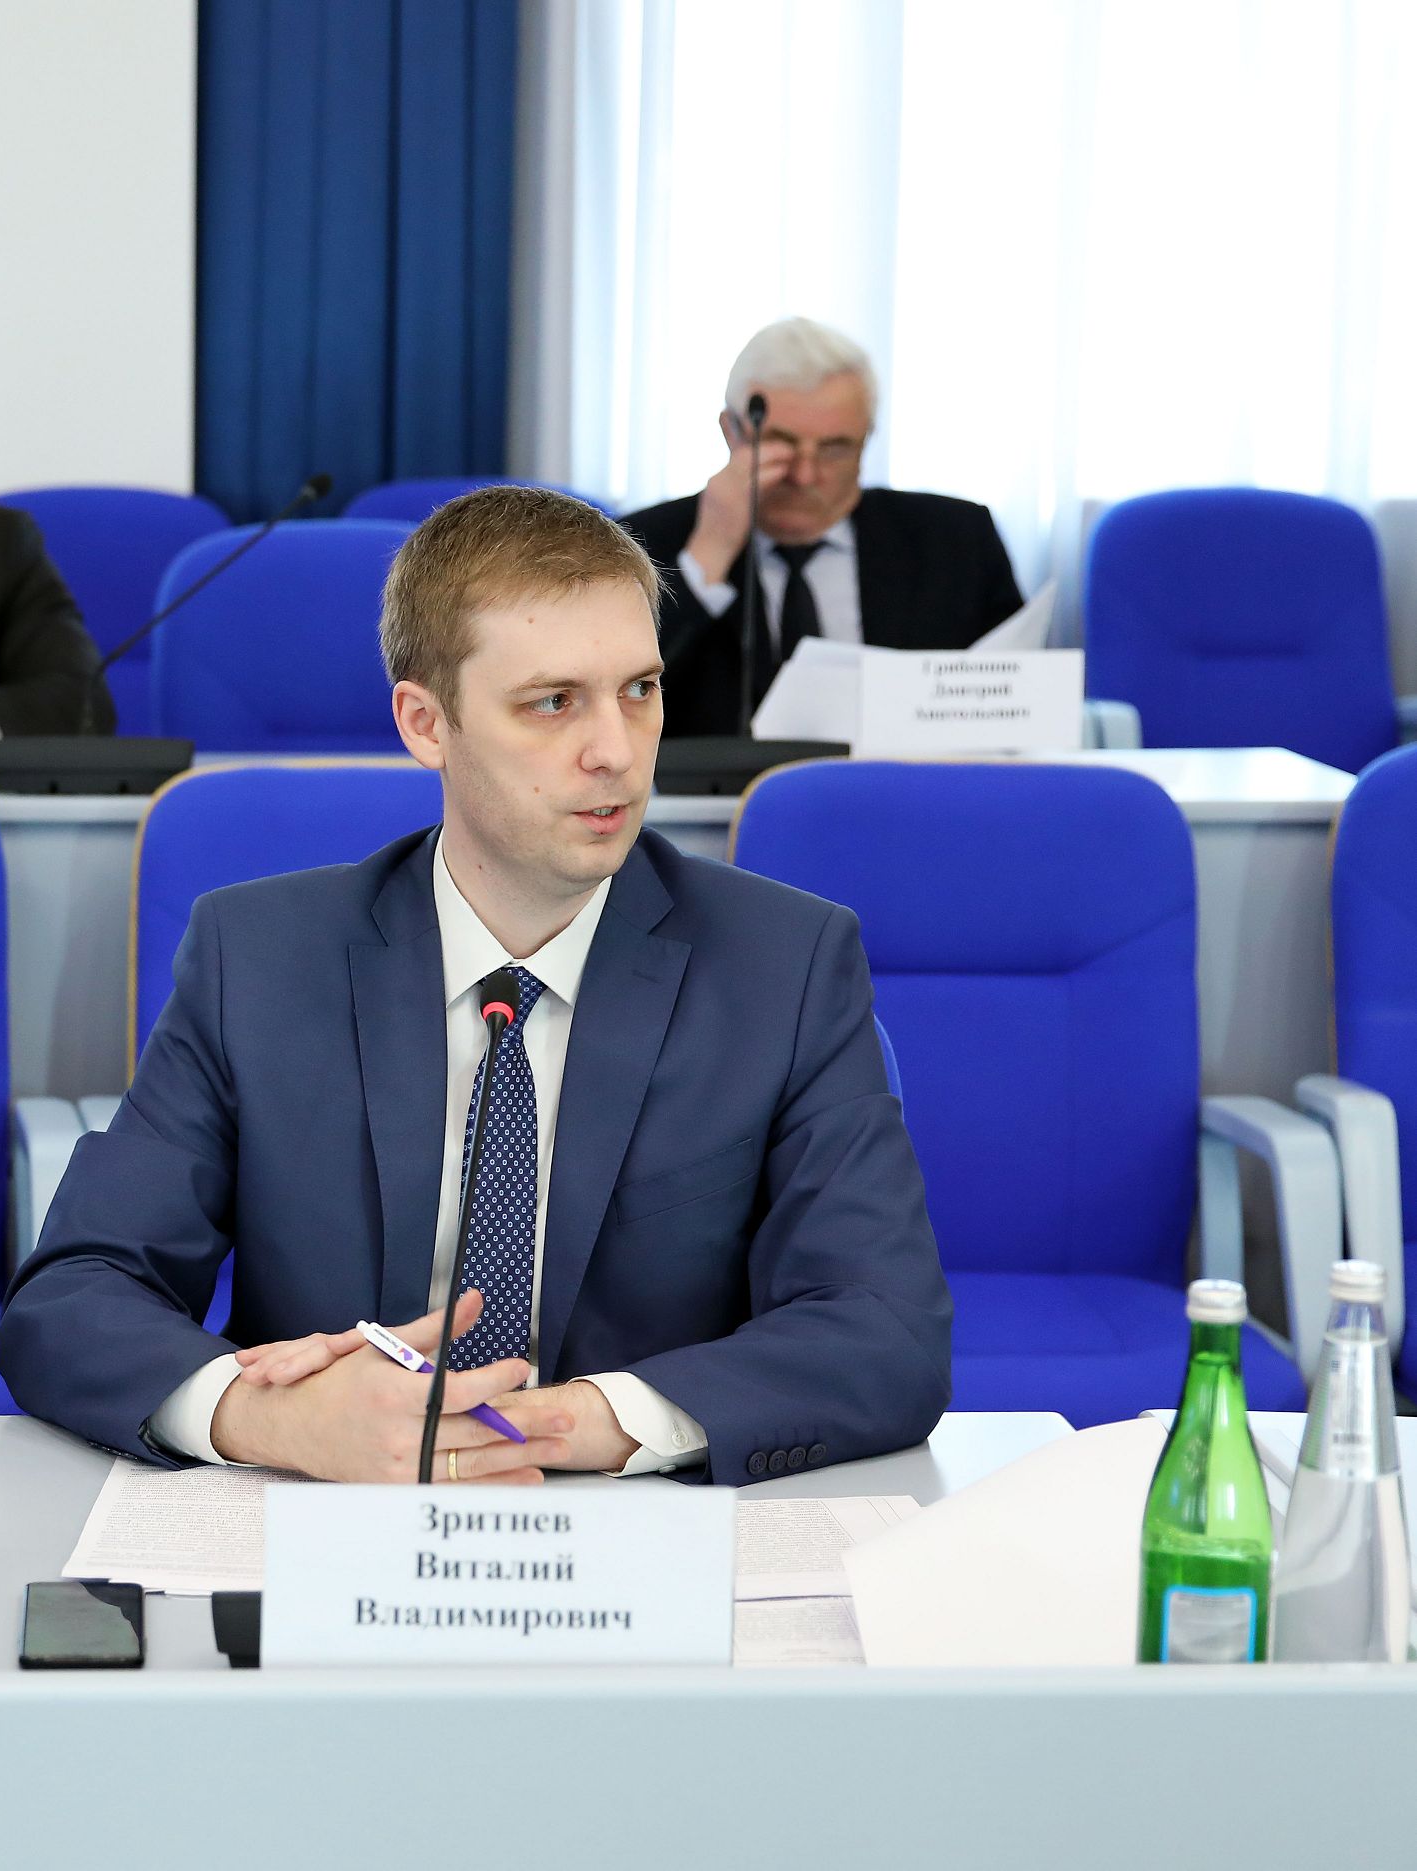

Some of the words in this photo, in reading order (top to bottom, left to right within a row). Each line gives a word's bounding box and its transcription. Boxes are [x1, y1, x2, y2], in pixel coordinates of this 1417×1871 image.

[420, 1503, 572, 1539] Зритнев
[415, 1551, 575, 1582] Виталий
[354, 1597, 633, 1637] Владимирович
